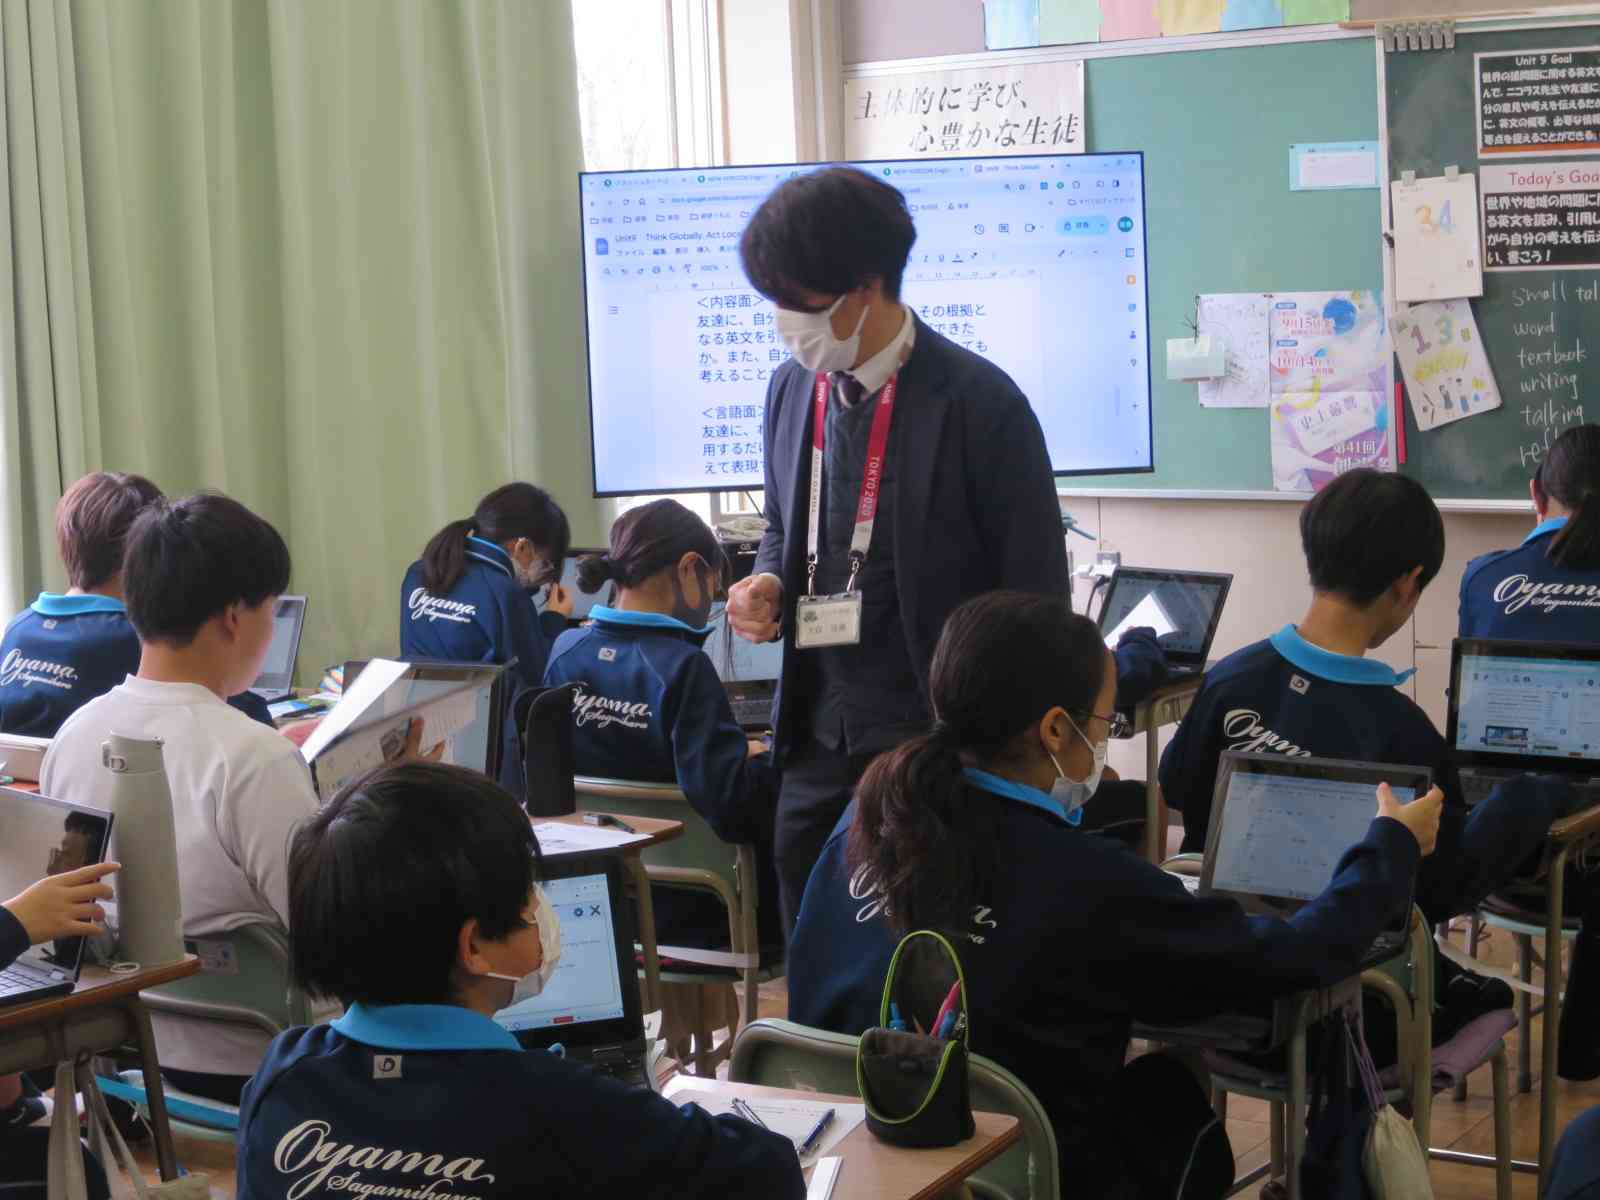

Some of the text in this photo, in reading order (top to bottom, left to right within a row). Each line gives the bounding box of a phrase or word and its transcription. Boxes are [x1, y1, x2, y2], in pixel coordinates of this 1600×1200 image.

[1515, 53, 1573, 66] Unit 9 Goal
[854, 80, 1027, 121] 主体的に学び、
[909, 113, 1079, 152] 心豊かな生徒
[1508, 170, 1565, 189] Today's
[1486, 193, 1600, 210] 世界や地域の問題に
[700, 367, 776, 382] 考えること
[1520, 372, 1579, 400] writing
[1520, 399, 1585, 427] talking
[864, 455, 881, 491] TOKYO
[1493, 573, 1600, 615] Oyam
[571, 686, 653, 727] yama
[274, 1119, 495, 1200] Oyama
